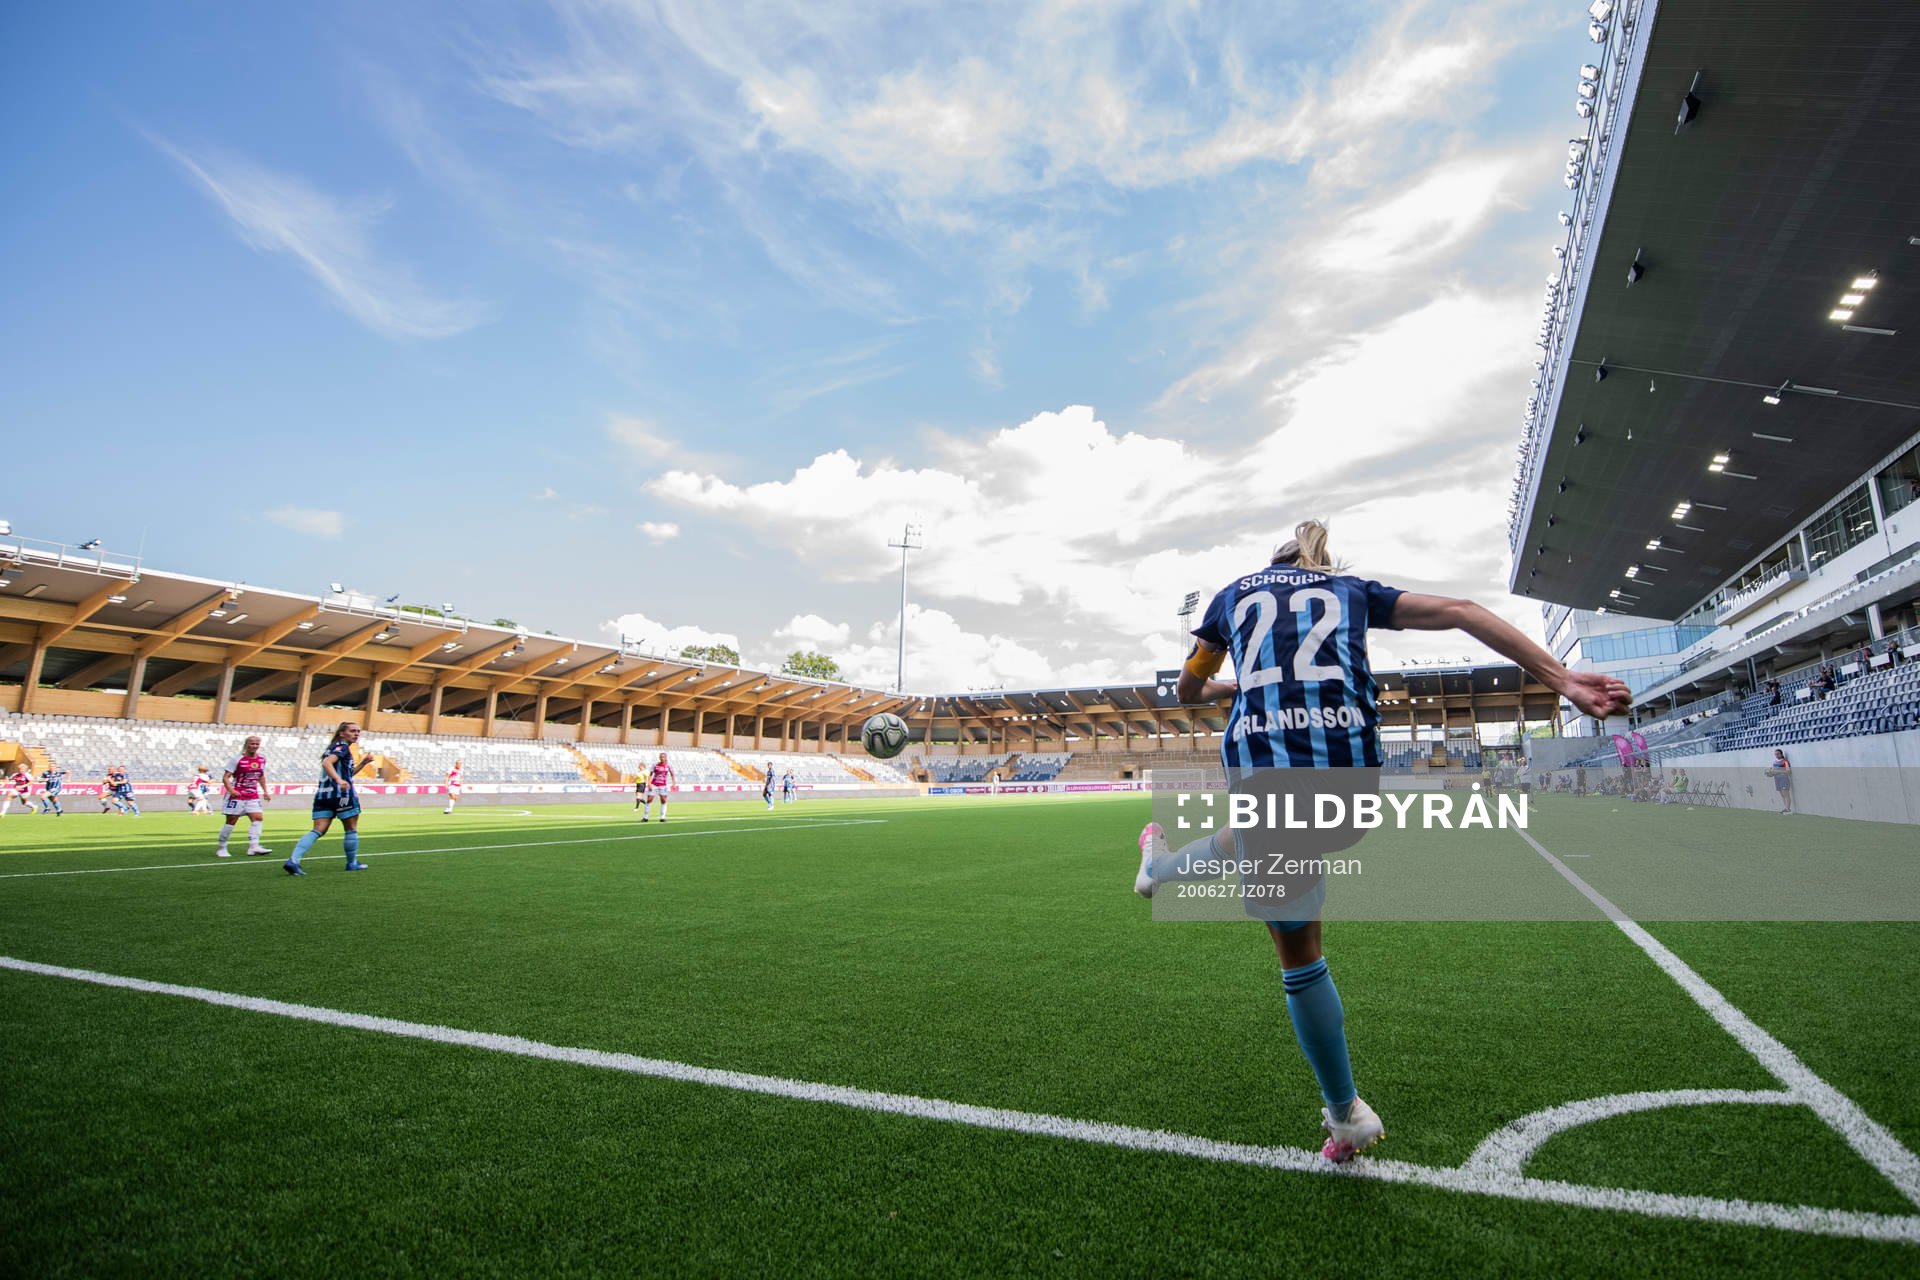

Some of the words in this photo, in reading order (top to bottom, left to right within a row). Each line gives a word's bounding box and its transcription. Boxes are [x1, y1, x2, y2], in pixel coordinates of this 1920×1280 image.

[1233, 587, 1345, 693] 22
[1232, 705, 1366, 743] ERLANDSSON
[35, 788, 86, 796] CAFT
